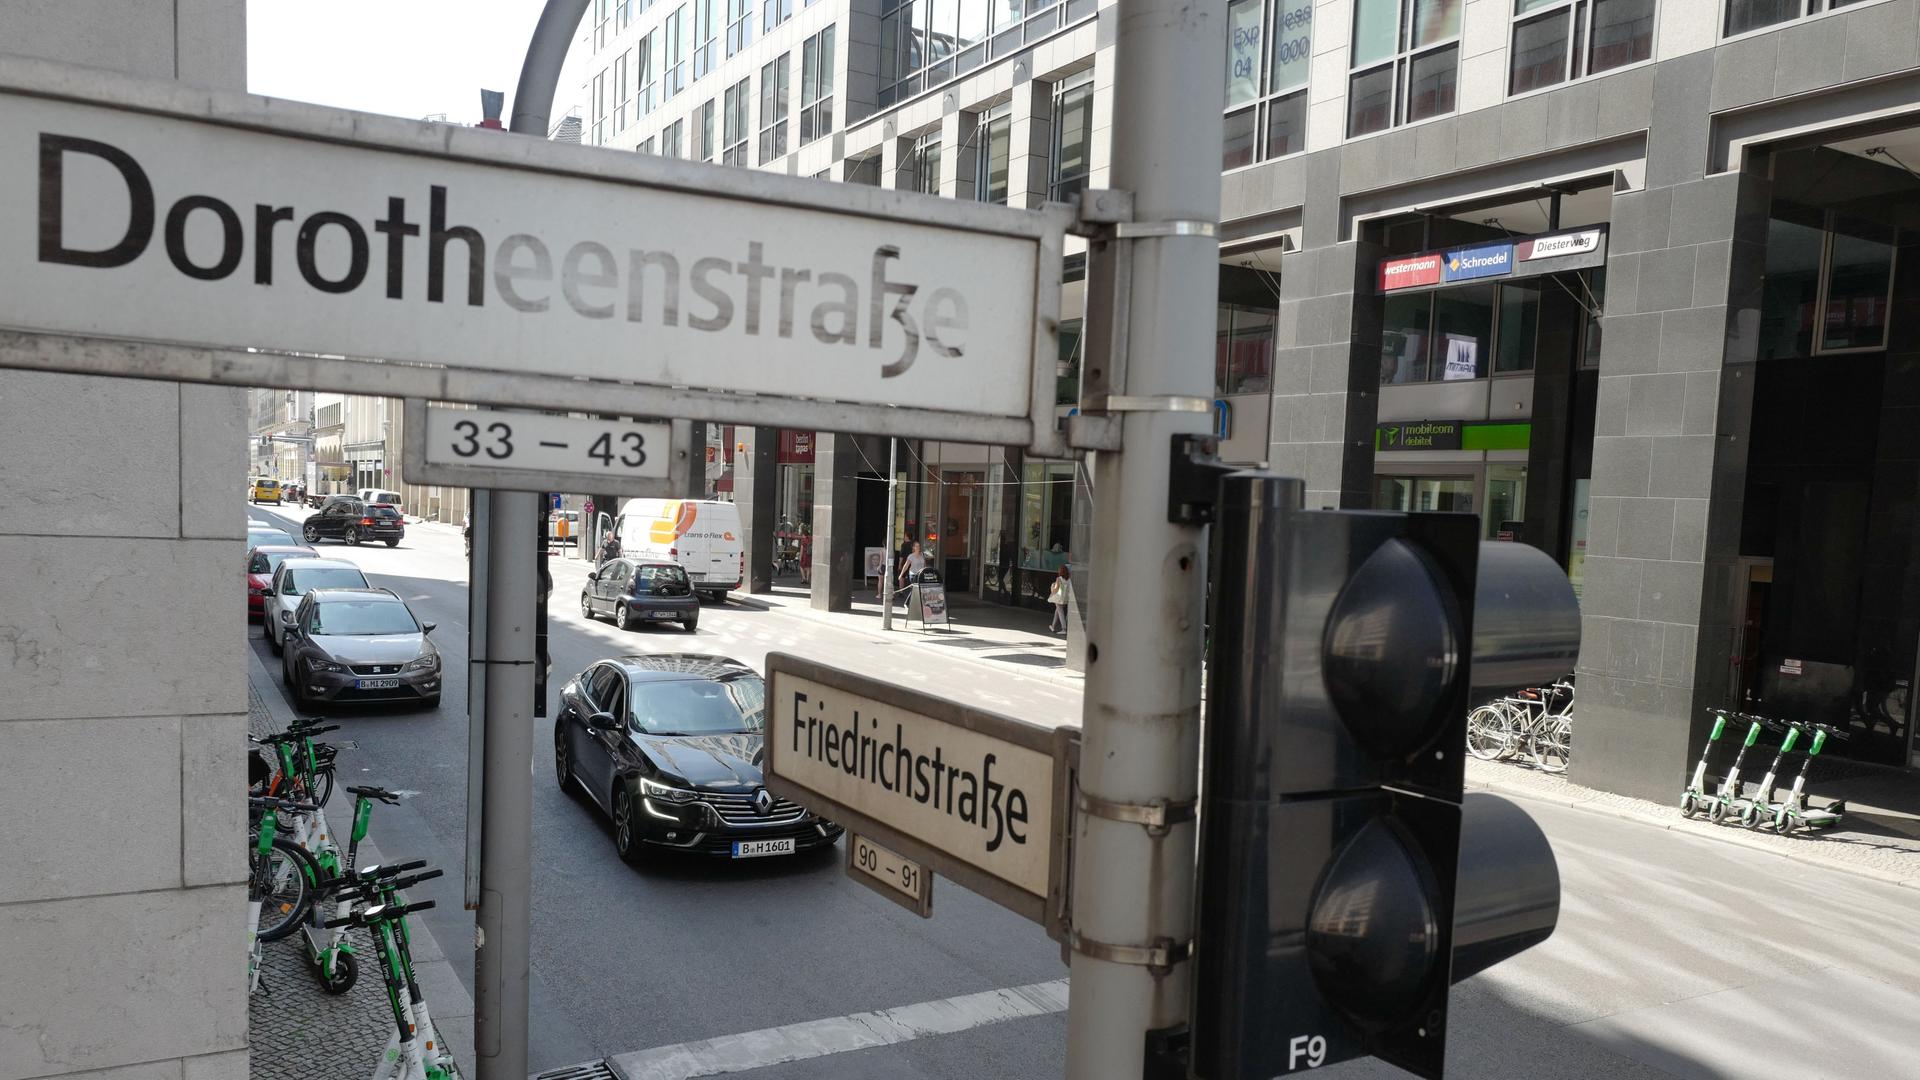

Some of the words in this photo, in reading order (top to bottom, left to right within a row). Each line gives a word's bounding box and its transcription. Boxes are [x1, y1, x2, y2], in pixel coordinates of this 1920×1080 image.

[38, 131, 969, 379] Dorotheenstraße
[1462, 252, 1507, 270] Schroedel
[1537, 235, 1590, 252] Diesterweg
[452, 420, 513, 460] 33
[588, 432, 646, 467] 43
[1405, 423, 1454, 435] mobilcom
[1405, 435, 1432, 446] debitel
[793, 691, 1028, 852] Friedrichstraße
[860, 844, 876, 871] 90
[903, 865, 917, 892] 91
[1288, 1034, 1327, 1070] F9
